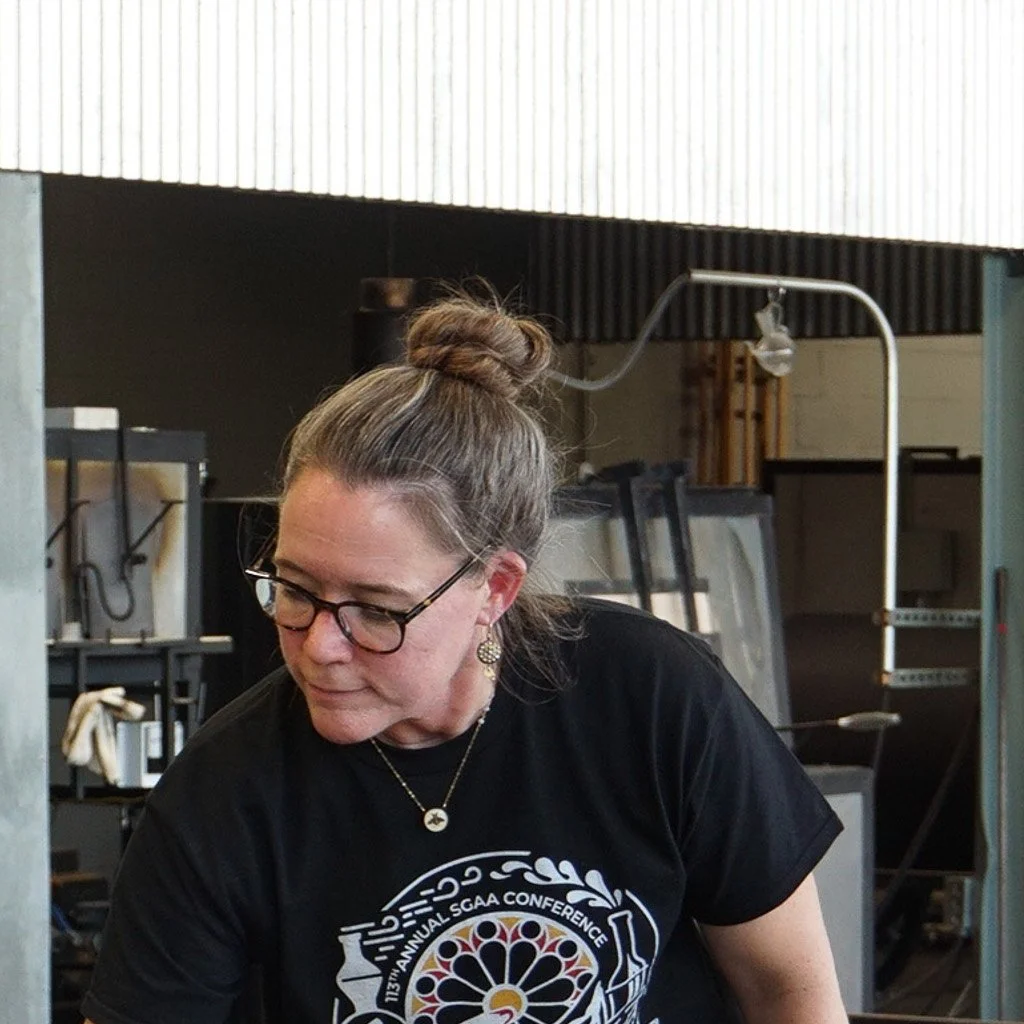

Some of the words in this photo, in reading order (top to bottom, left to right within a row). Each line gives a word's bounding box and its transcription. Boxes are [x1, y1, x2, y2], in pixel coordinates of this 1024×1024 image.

[396, 912, 451, 973] ANNUAL
[449, 892, 501, 917] SGAA
[503, 891, 608, 948] CONFERENCE
